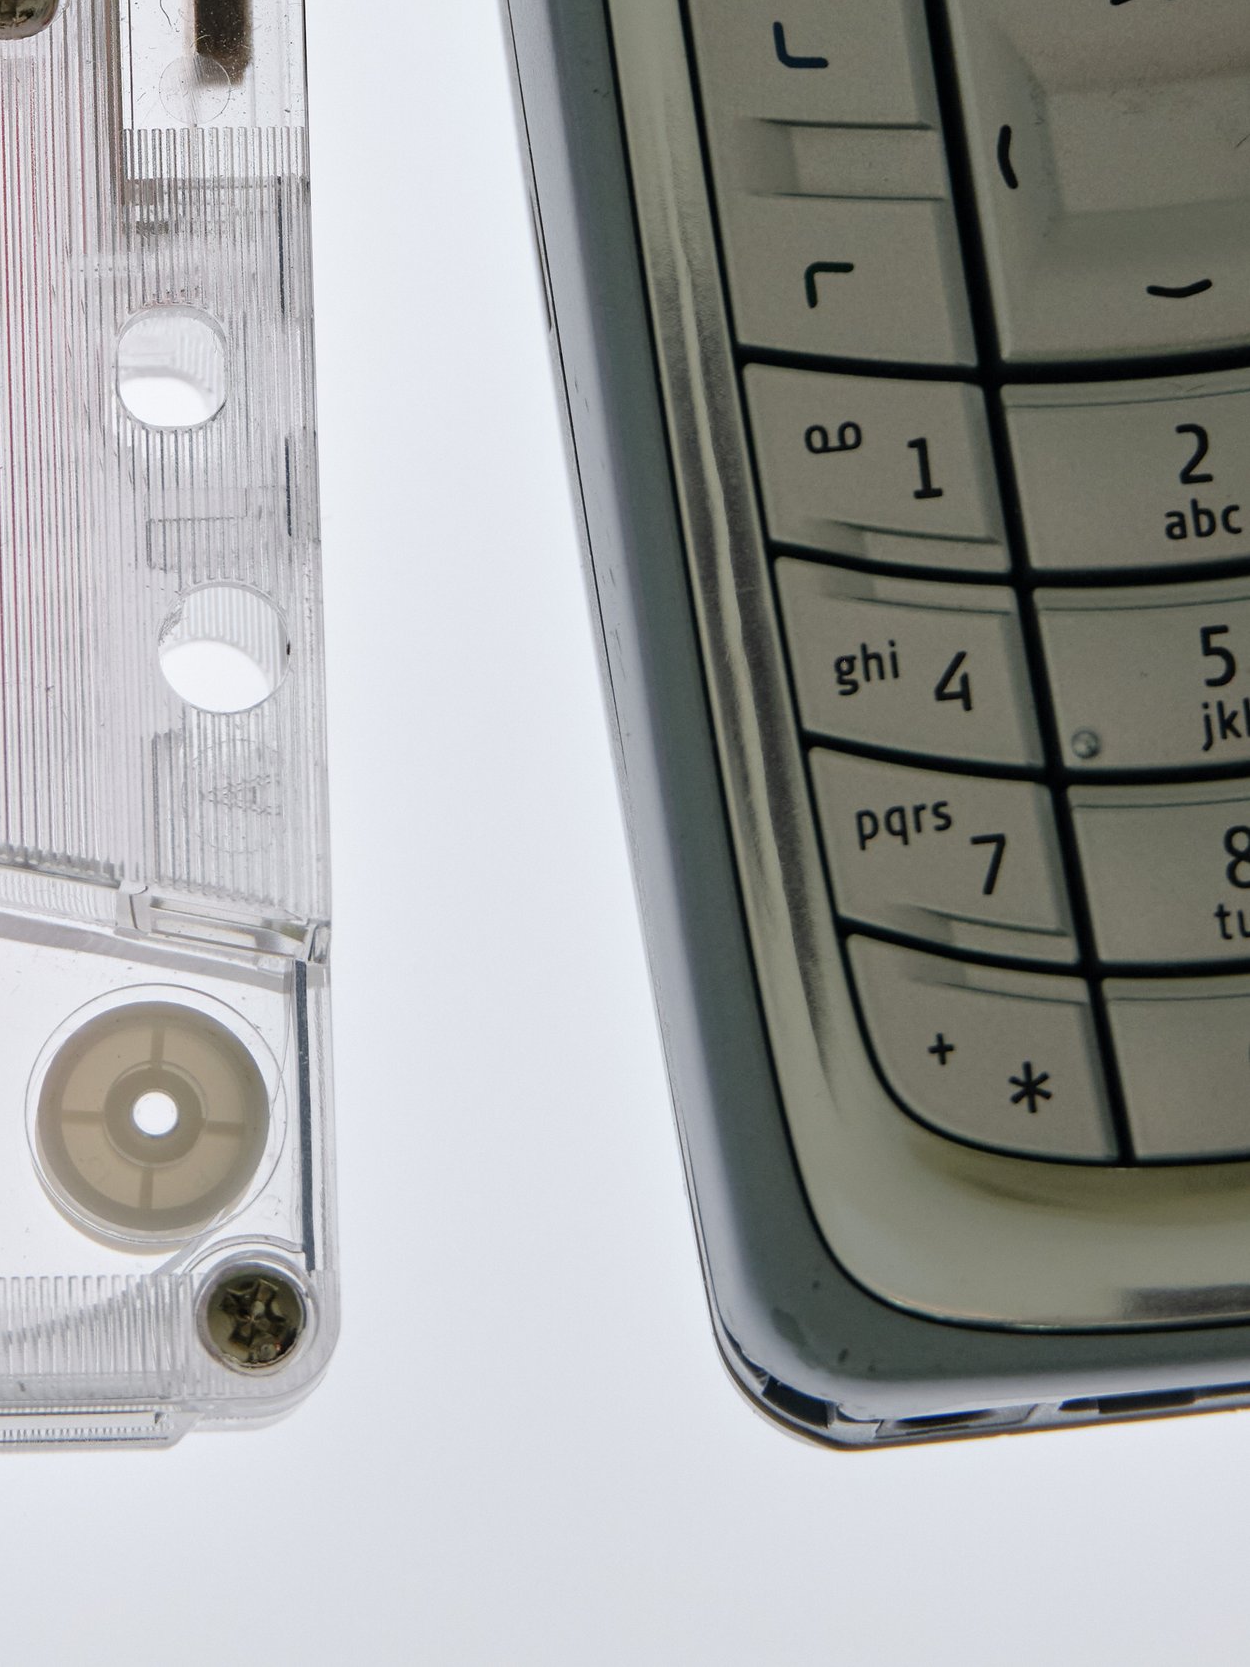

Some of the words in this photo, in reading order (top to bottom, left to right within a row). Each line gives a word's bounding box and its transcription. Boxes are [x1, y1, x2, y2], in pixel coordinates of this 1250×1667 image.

[906, 437, 944, 499] 1
[1175, 423, 1215, 485] 2
[1164, 498, 1243, 540] abc
[834, 640, 900, 696] ghi
[933, 650, 973, 712] 4
[1199, 624, 1237, 687] 5
[1201, 697, 1250, 751] jkl
[855, 800, 953, 851] pqrs
[970, 833, 1007, 895] 7
[1224, 825, 1250, 889] 8
